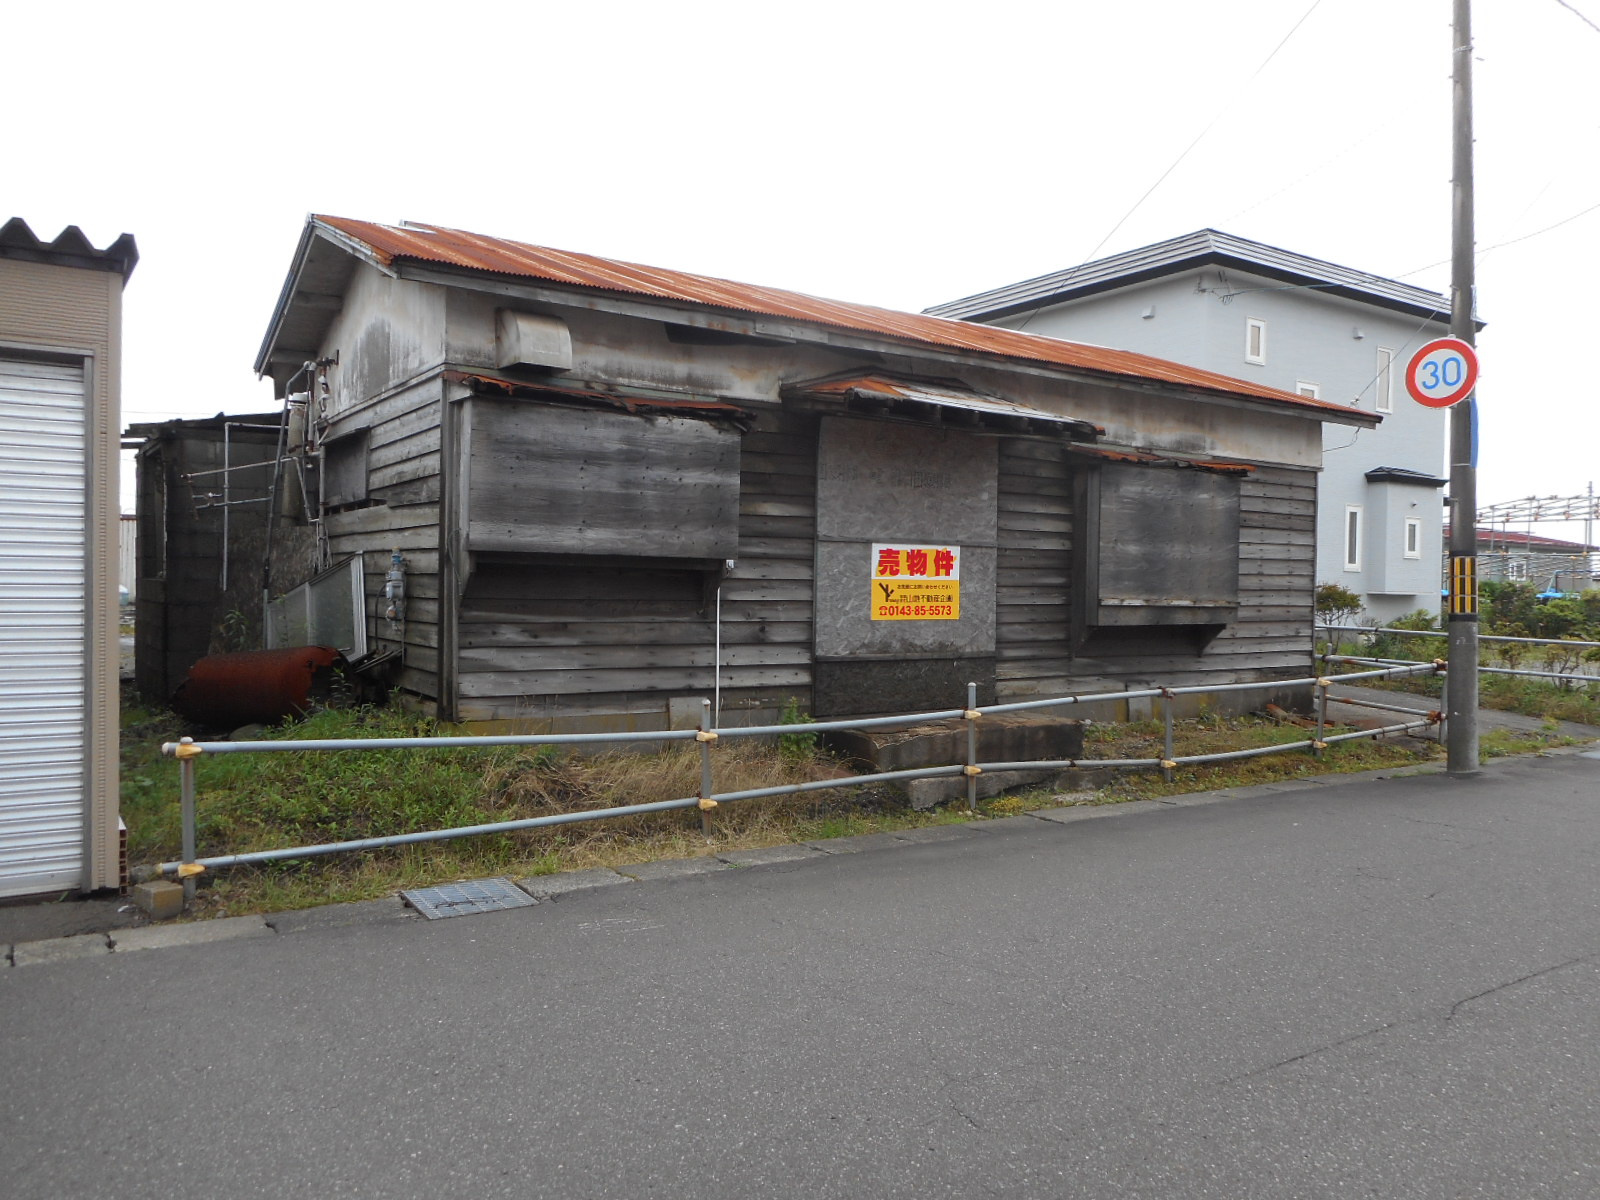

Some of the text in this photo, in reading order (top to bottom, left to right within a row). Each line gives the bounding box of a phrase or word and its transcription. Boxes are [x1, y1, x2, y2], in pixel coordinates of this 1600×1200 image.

[1422, 357, 1462, 390] 30
[878, 548, 954, 577] 売物件
[888, 605, 952, 616] 0143-85-5573
